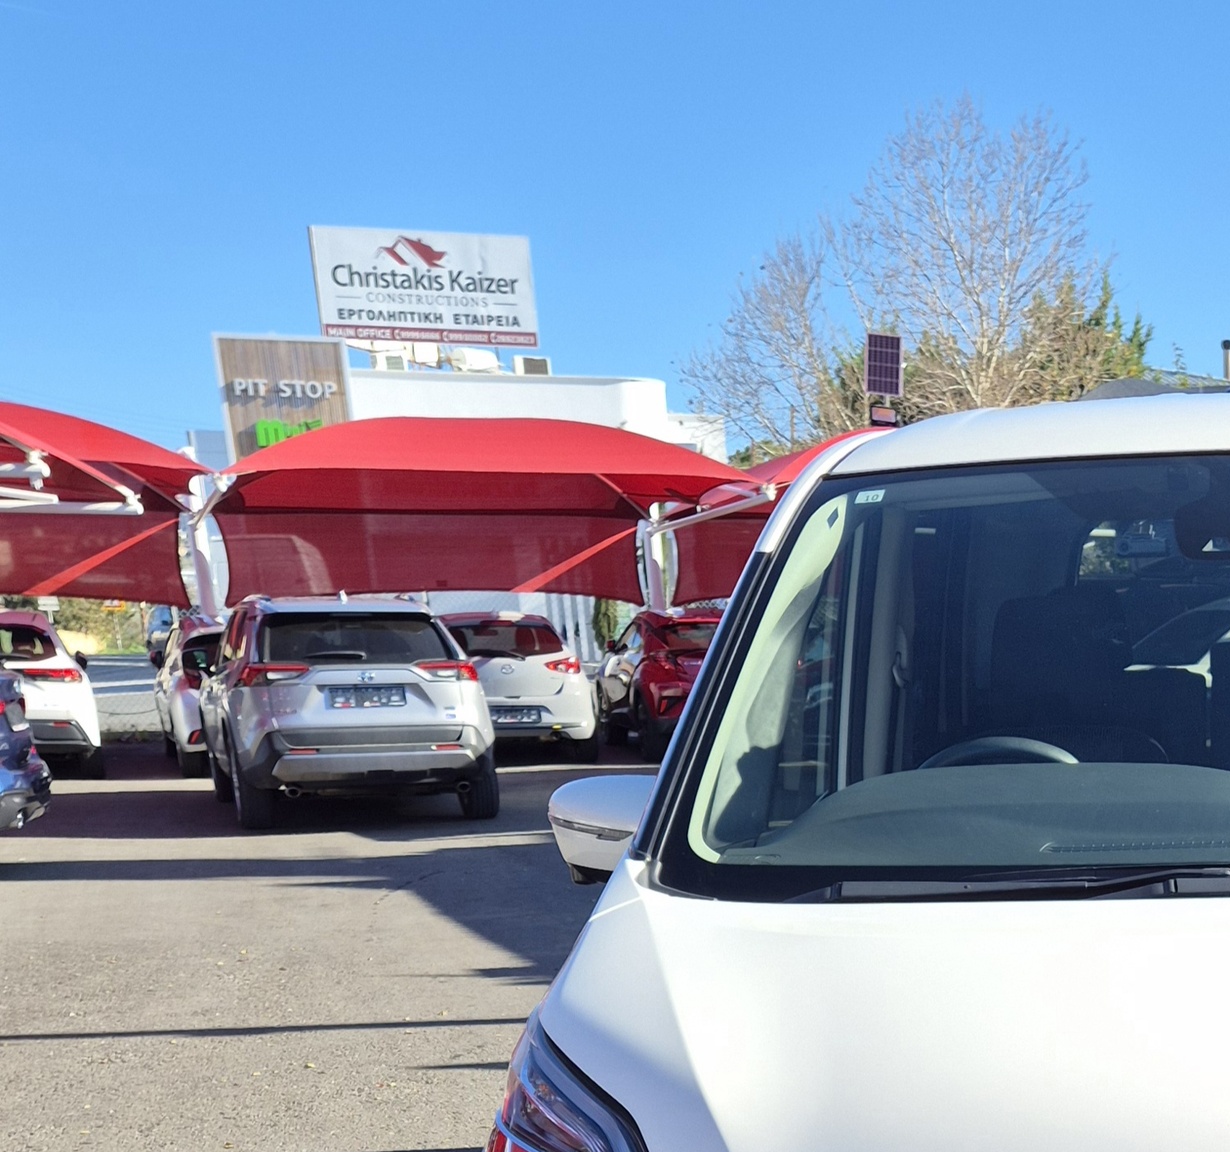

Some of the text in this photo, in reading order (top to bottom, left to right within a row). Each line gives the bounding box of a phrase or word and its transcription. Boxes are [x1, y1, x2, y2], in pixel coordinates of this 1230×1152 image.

[331, 264, 518, 295] Christakis Kaizer
[366, 291, 489, 308] CONSTRUCTIONS
[337, 308, 521, 328] ΕΡΓΟΛΗΠΤΙΚΗ ΕΤΑΙΡΕΙΑ
[233, 378, 338, 399] PIT STOP
